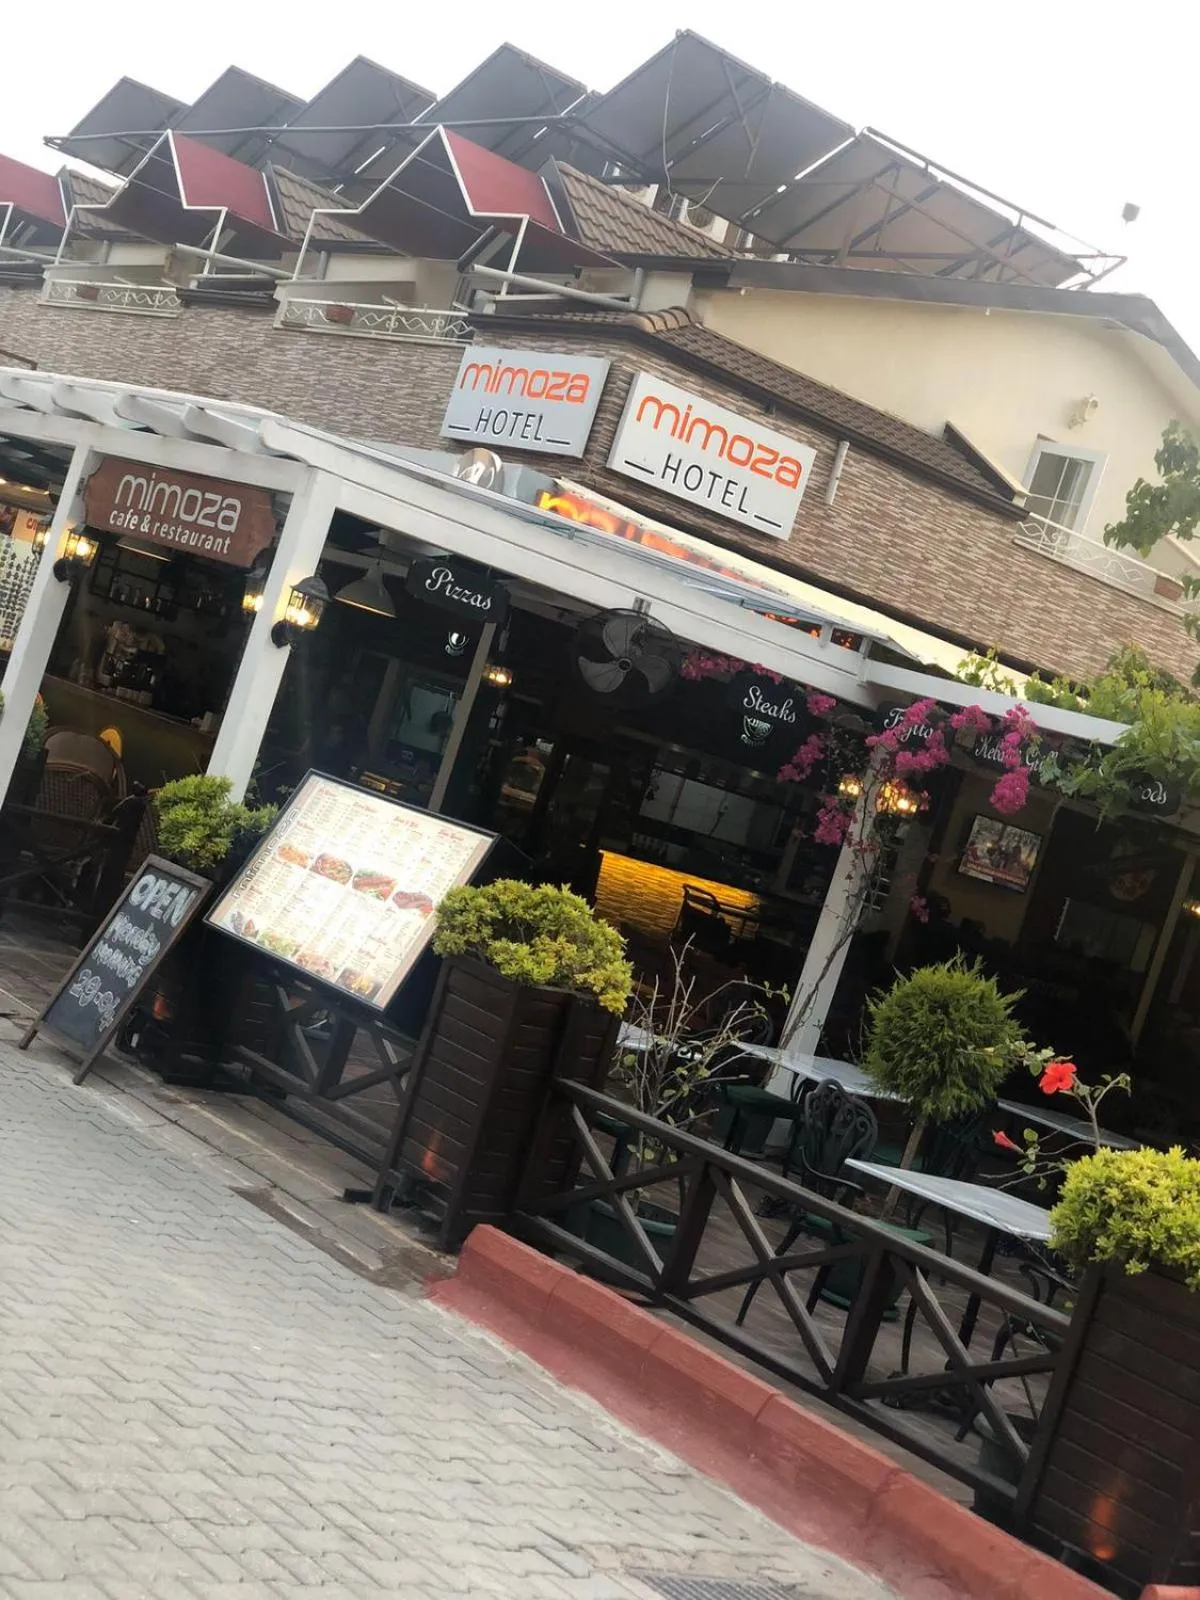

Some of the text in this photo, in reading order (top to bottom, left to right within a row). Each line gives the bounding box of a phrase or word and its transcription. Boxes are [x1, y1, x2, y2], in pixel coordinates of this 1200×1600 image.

[459, 358, 591, 404] mimoza
[474, 408, 542, 441] HOTEL
[635, 395, 803, 490] mimoza
[114, 473, 242, 533] mimoza
[660, 453, 749, 514] HOTEL
[109, 509, 232, 554] cafe & restaurant
[424, 566, 492, 610] Pizzas
[742, 685, 797, 724] Steaks
[128, 874, 199, 928] OPEN
